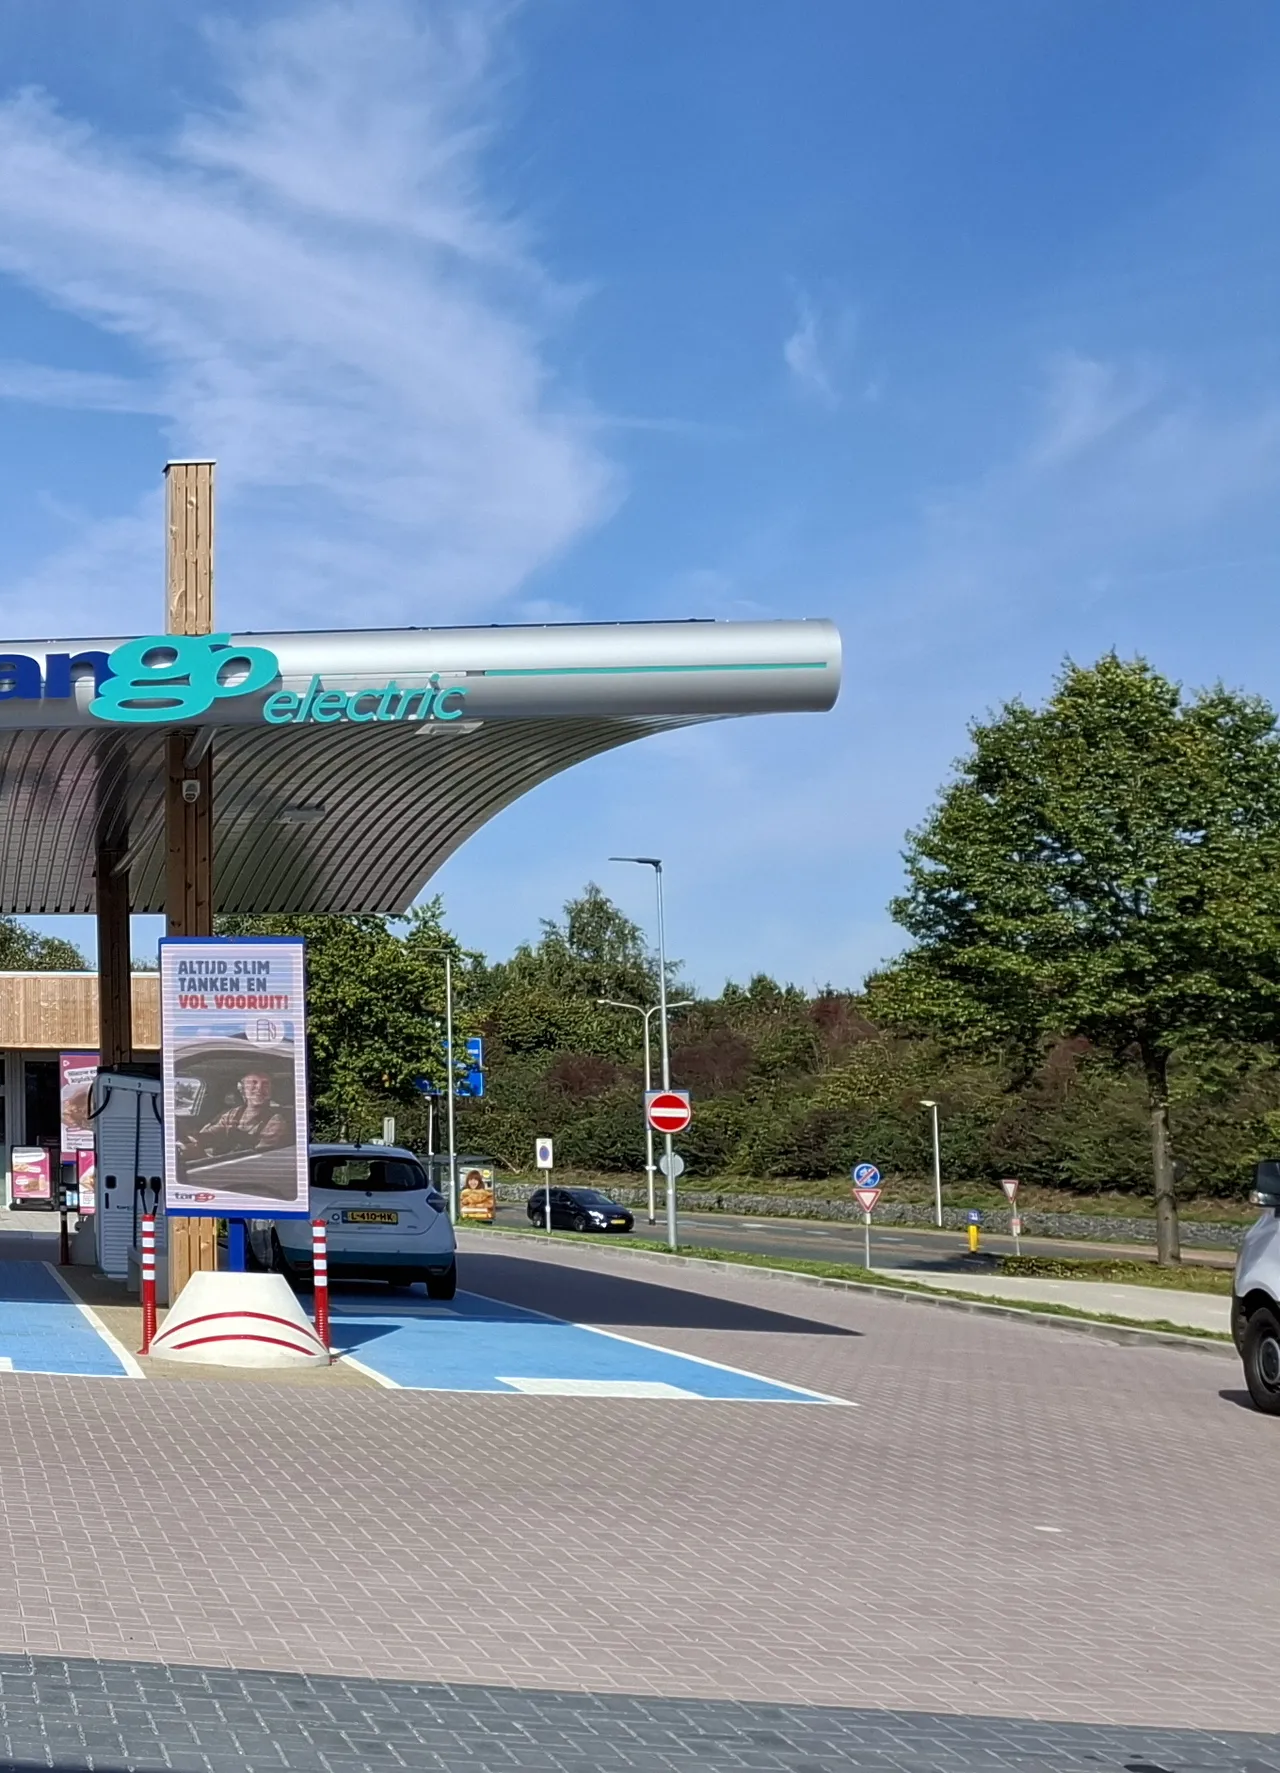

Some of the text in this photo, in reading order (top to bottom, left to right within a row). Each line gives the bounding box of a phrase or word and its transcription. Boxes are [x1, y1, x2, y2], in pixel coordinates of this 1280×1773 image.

[263, 672, 468, 723] electric
[178, 960, 270, 975] ALTIJD SLIM
[178, 977, 267, 992] TANKEN EN
[178, 994, 289, 1010] VOL VOORUIT!
